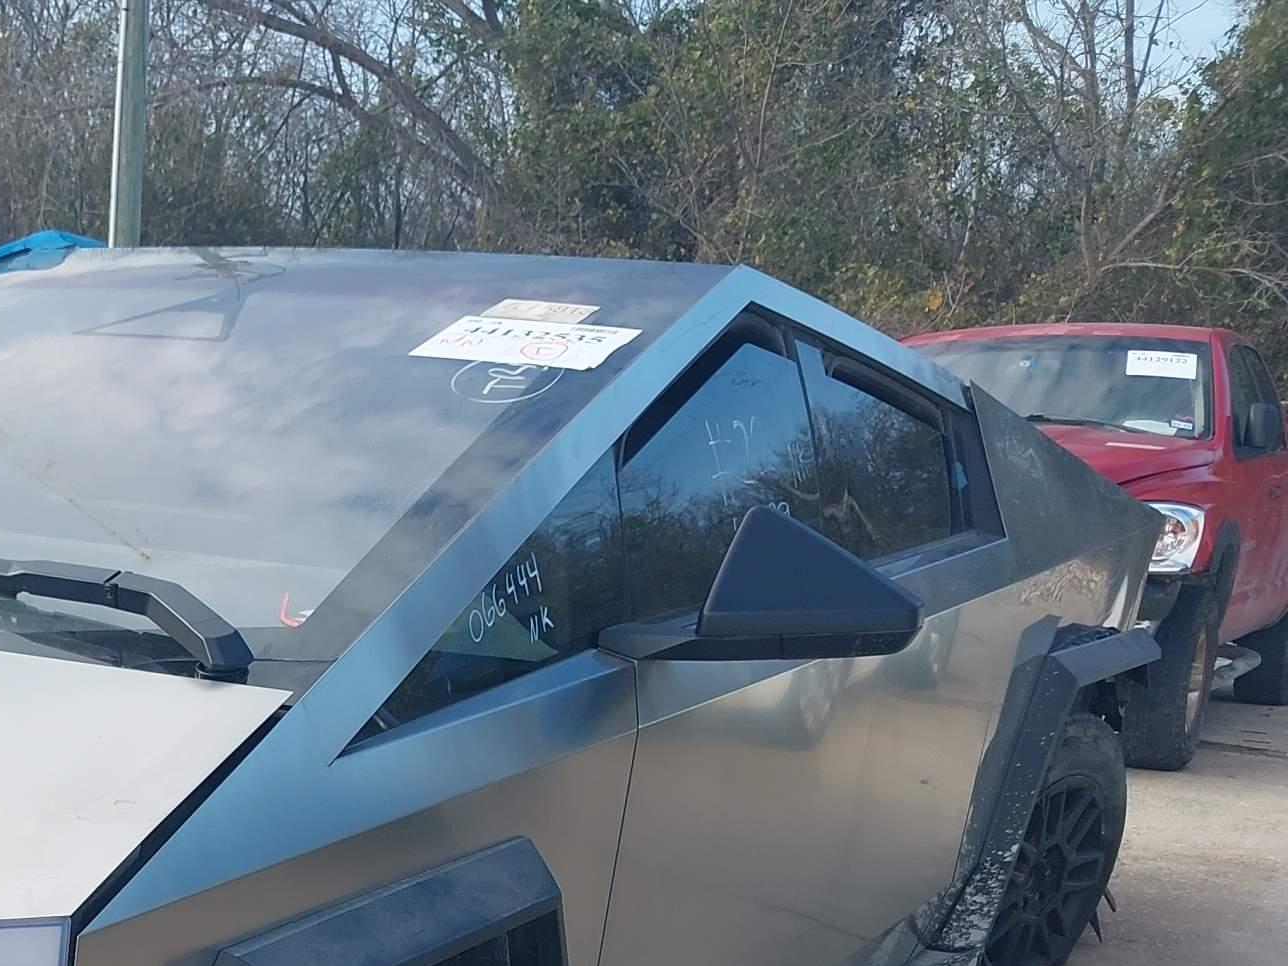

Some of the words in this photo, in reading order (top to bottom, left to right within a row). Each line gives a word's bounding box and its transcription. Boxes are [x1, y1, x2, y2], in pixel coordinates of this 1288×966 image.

[464, 325, 608, 345] 44132535
[469, 552, 543, 642] 066444
[529, 604, 555, 644] NK
